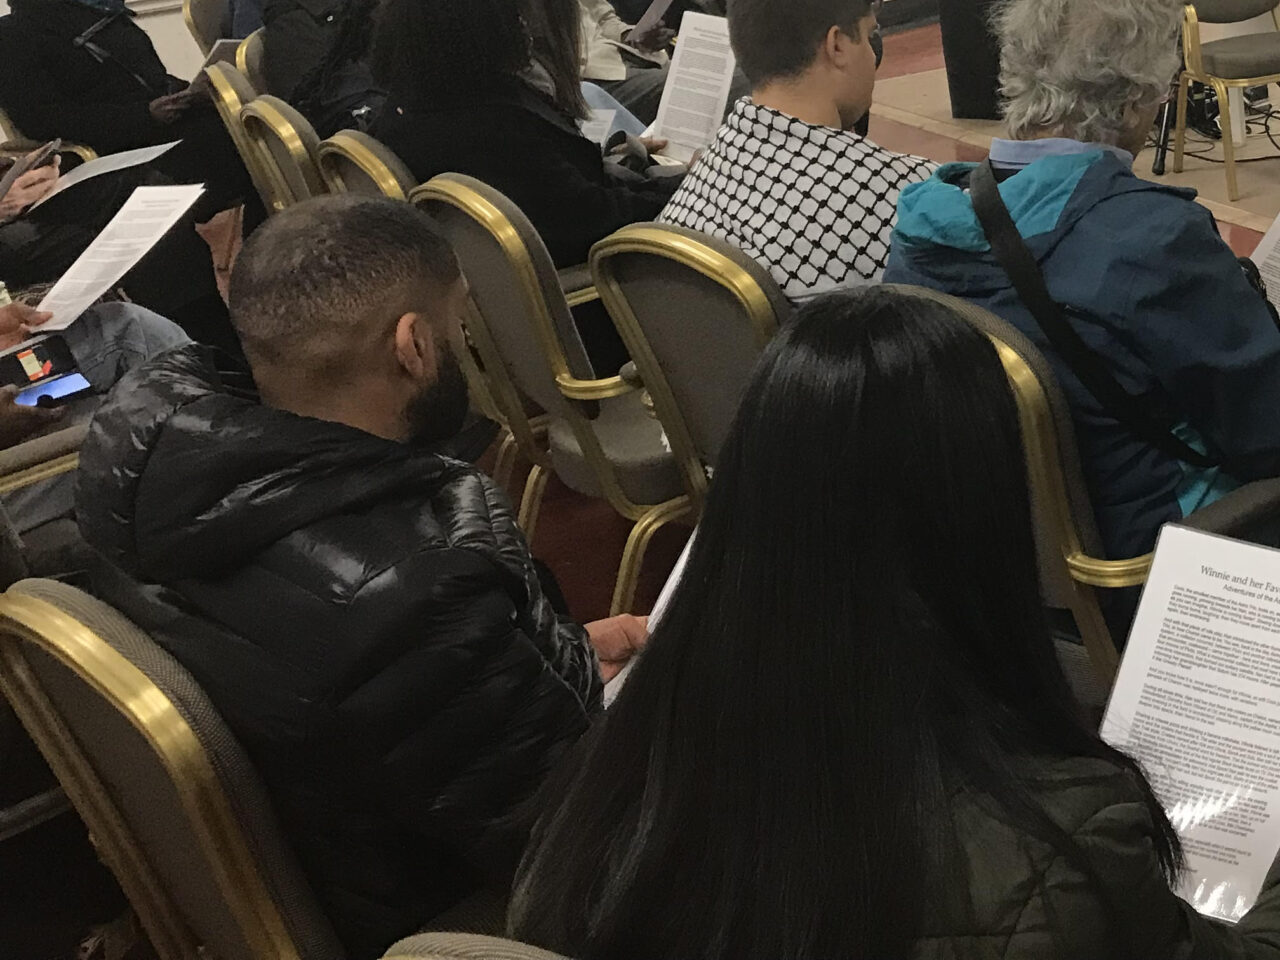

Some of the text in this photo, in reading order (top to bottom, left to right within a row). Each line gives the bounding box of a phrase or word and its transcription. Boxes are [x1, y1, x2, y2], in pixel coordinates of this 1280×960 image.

[1201, 564, 1231, 581] Winnie
[1231, 575, 1249, 586] and
[1248, 577, 1265, 590] her
[1222, 583, 1256, 598] Adventures
[1263, 594, 1274, 602] the
